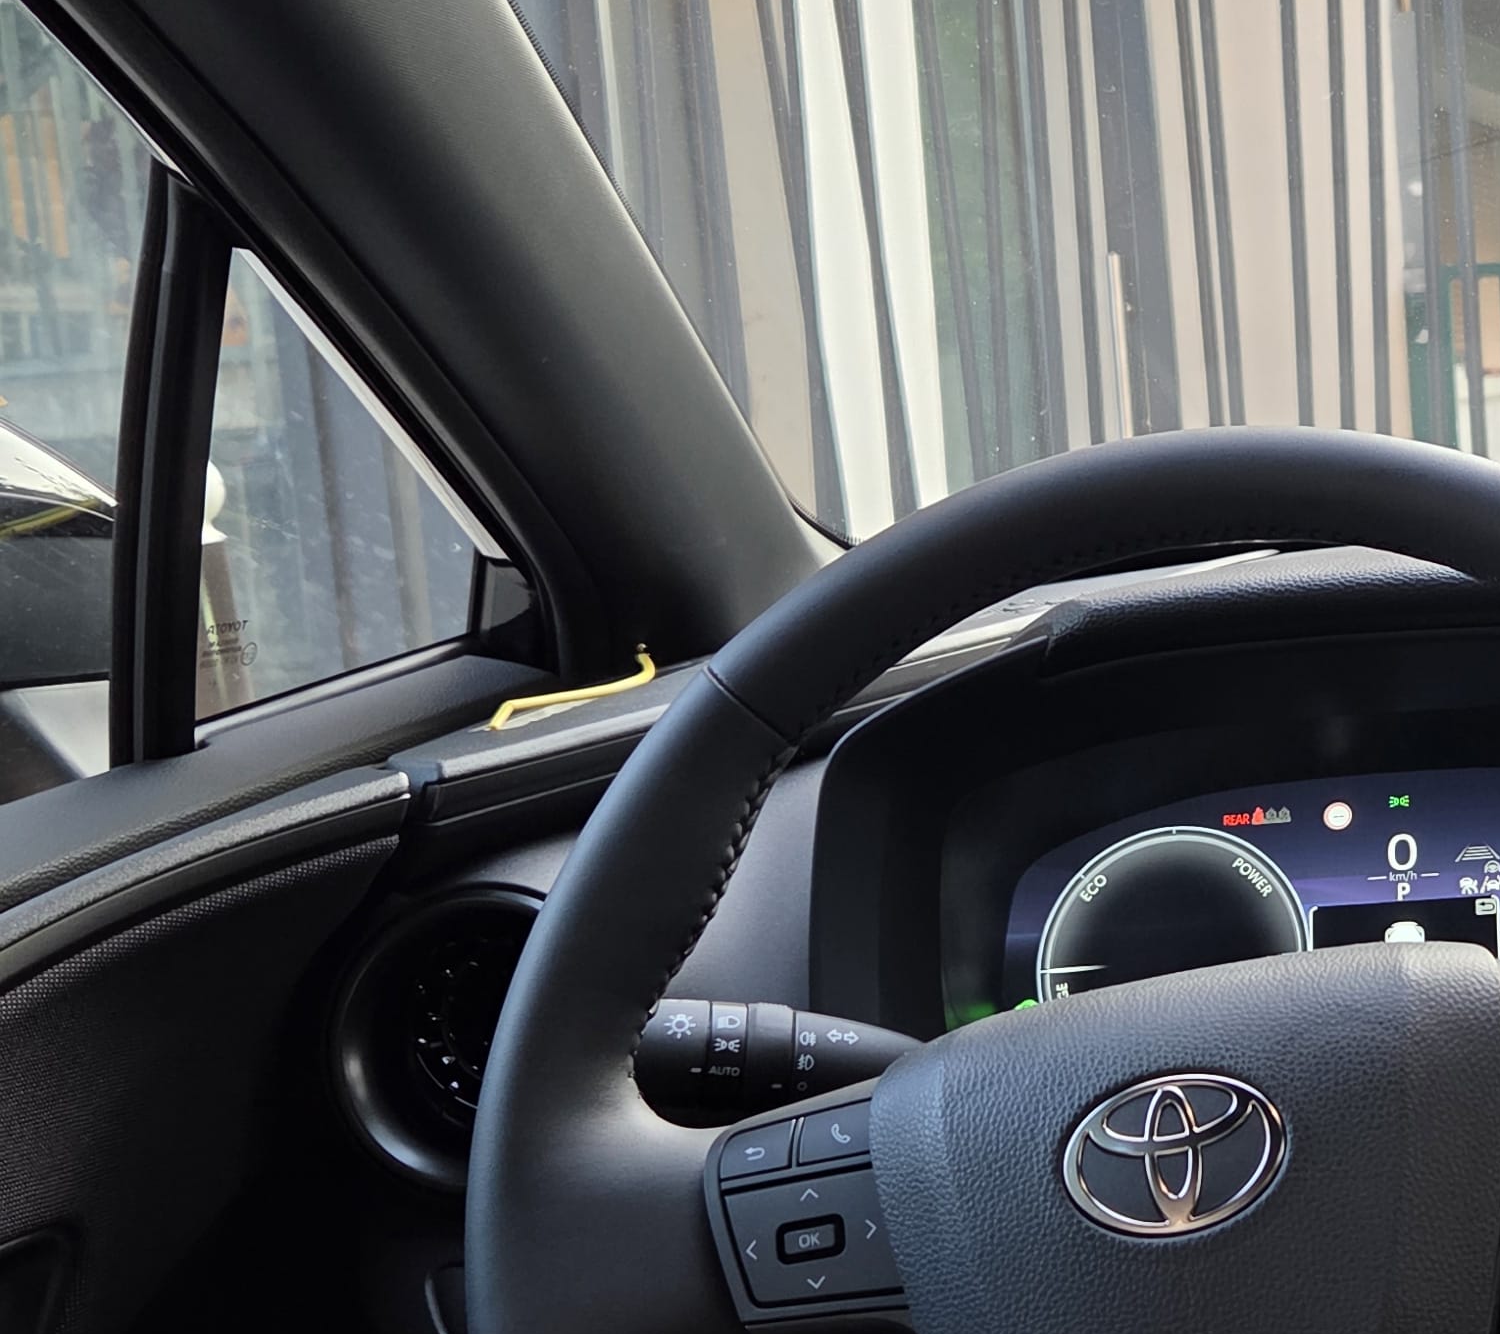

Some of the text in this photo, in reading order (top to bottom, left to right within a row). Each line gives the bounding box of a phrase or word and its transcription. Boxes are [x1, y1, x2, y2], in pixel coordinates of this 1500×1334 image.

[1222, 813, 1250, 826] REAR
[1387, 833, 1418, 871] 0
[1231, 857, 1273, 898] POWER
[1389, 870, 1418, 882] km/h
[1079, 873, 1108, 903] ECO
[1396, 882, 1411, 901] P
[708, 1065, 741, 1077] AUTO
[798, 1232, 820, 1248] OK
